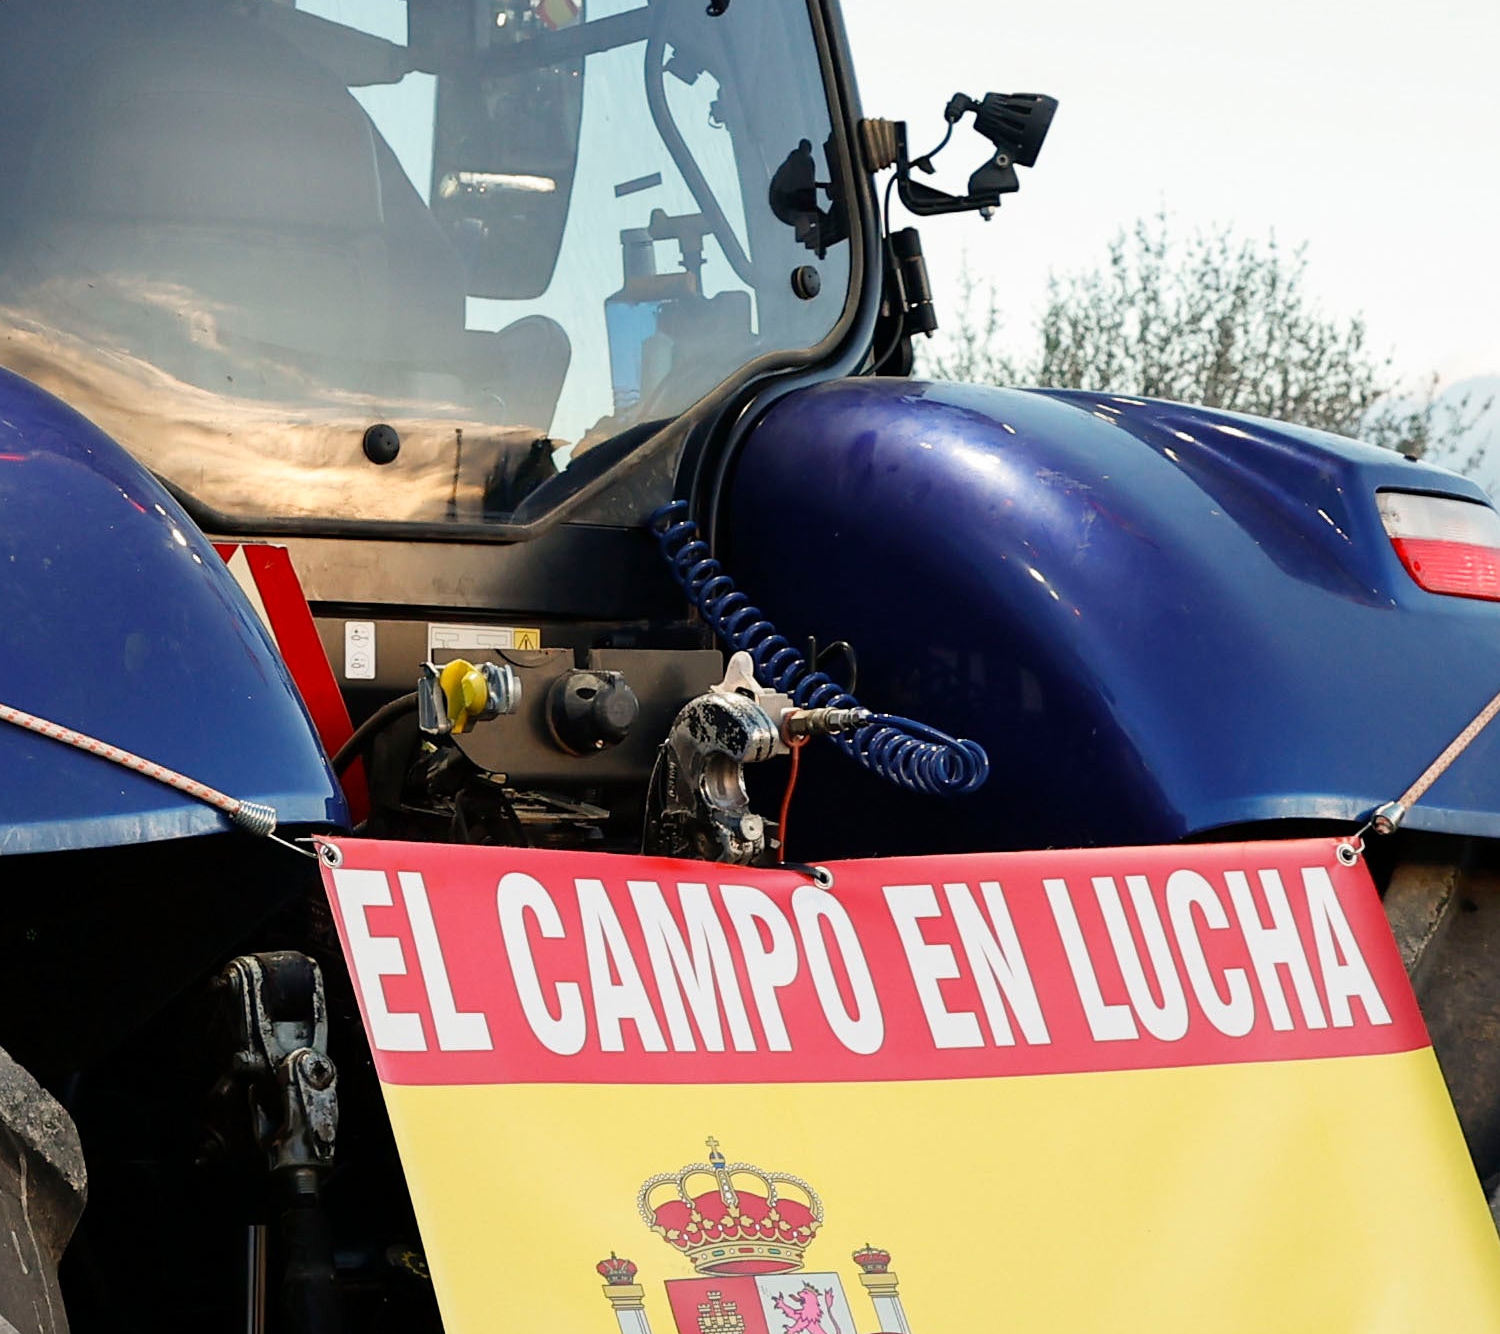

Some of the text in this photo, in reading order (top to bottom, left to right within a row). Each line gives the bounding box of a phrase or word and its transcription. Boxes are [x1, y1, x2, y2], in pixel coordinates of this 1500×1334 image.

[342, 867, 1394, 1056] EL CAMPO EN LUCHA
